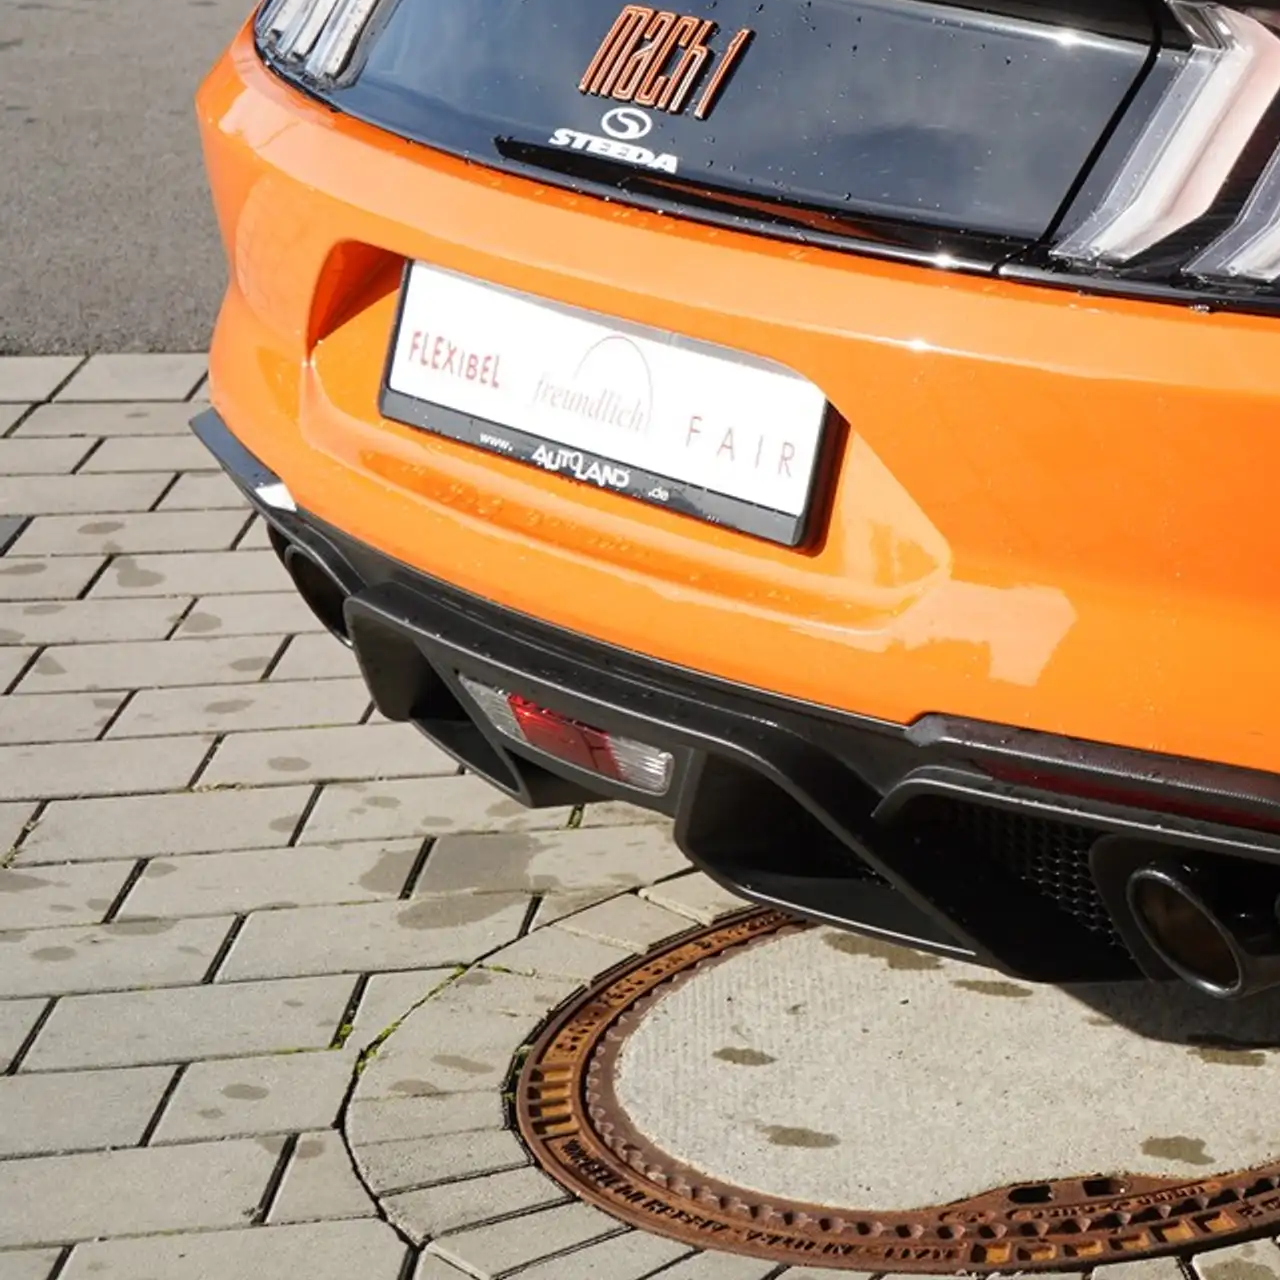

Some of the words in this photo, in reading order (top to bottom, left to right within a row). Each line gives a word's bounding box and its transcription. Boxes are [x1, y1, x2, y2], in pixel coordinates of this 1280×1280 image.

[693, 28, 750, 120] 1
[548, 128, 679, 174] STEEDA
[408, 330, 501, 389] FLEXIBEL
[526, 372, 645, 432] freundlich
[479, 432, 514, 452] www.
[531, 444, 631, 487] AUTOLAND
[648, 486, 670, 502] .de
[686, 415, 797, 478] FAIR
